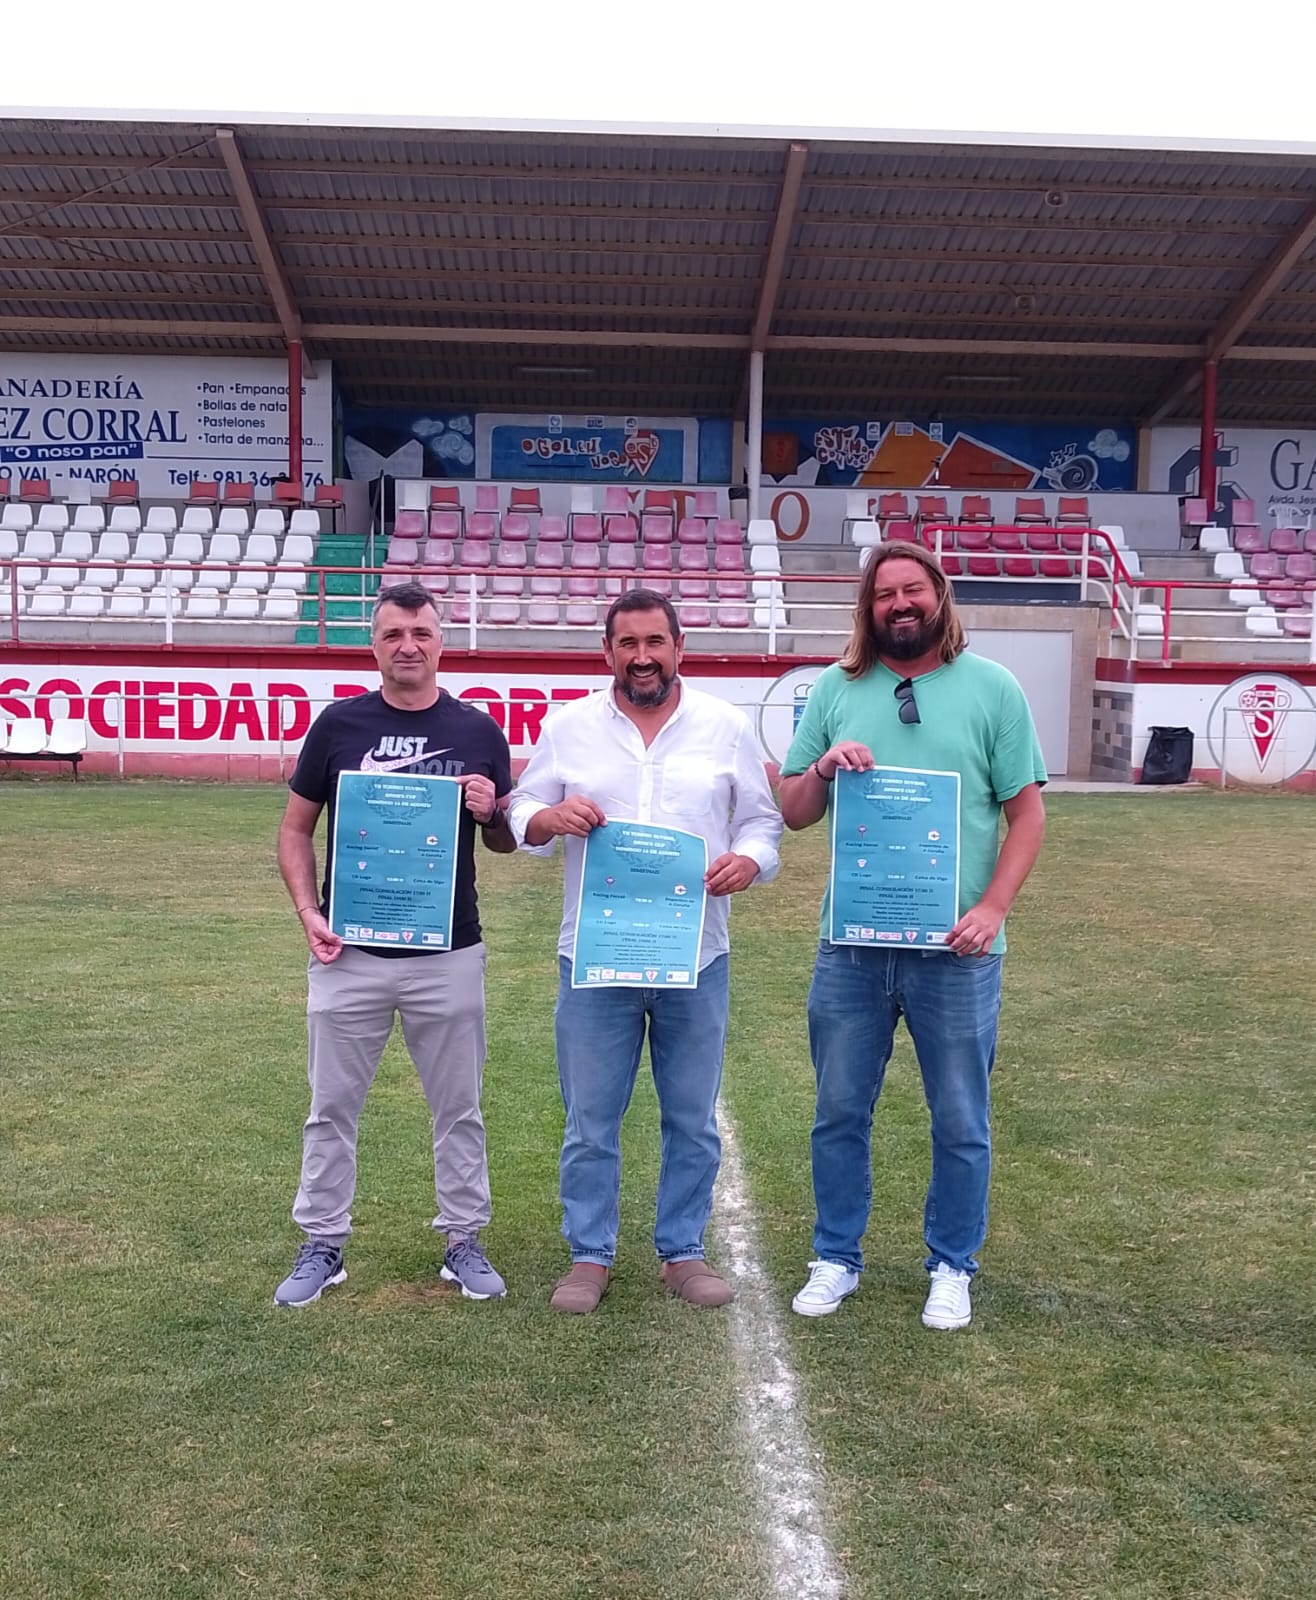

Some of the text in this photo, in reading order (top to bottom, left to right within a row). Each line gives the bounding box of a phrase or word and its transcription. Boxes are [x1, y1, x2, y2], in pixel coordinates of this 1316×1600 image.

[203, 382, 225, 394] Pan
[240, 401, 256, 412] de
[260, 401, 287, 412] nata
[42, 408, 187, 443] CORRAL
[203, 416, 265, 428] Pastelones
[204, 433, 233, 444] Tarta
[241, 434, 253, 445] de
[37, 447, 84, 458] noso
[69, 464, 136, 483] NARÓN
[0, 678, 311, 742] SOCIEDAD
[374, 735, 428, 757] JUST
[447, 760, 465, 776] IT
